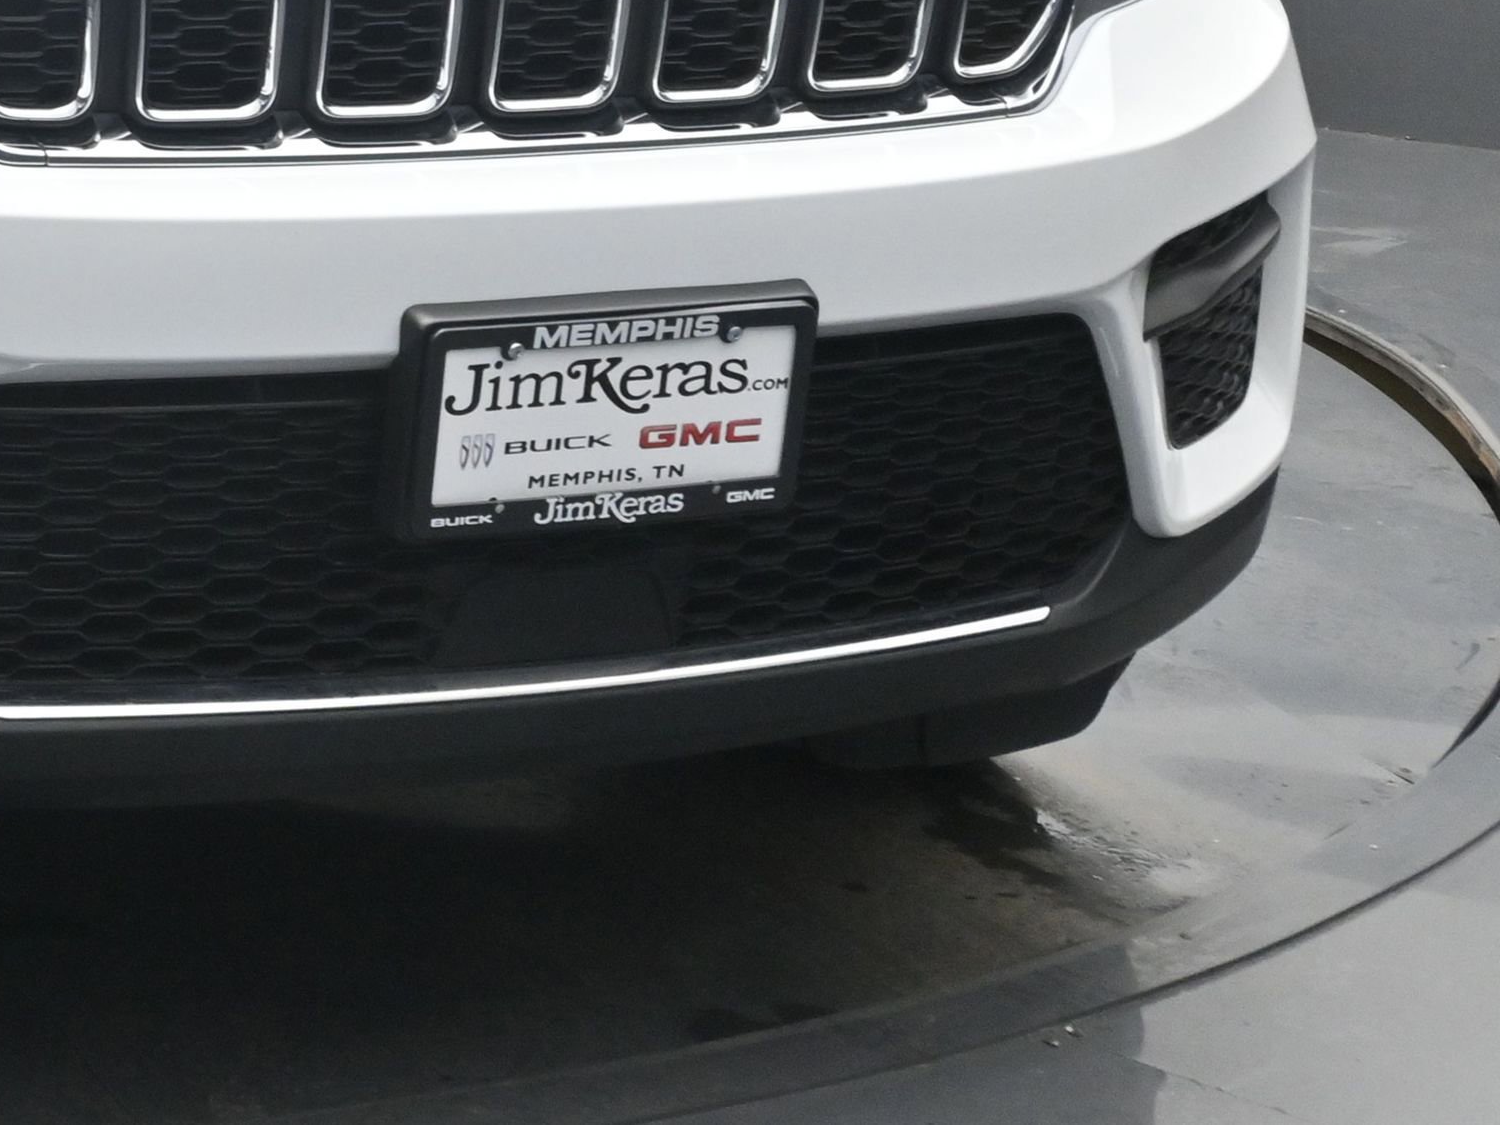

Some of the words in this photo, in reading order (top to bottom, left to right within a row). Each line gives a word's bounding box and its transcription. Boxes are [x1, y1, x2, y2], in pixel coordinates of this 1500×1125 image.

[533, 314, 720, 349] MEMPHIS
[504, 434, 612, 455] BUICK
[639, 418, 762, 449] GMC
[528, 468, 643, 489] MEMPHIS,
[653, 464, 685, 479] TN
[726, 488, 776, 504] GMC
[430, 514, 494, 528] BUICK
